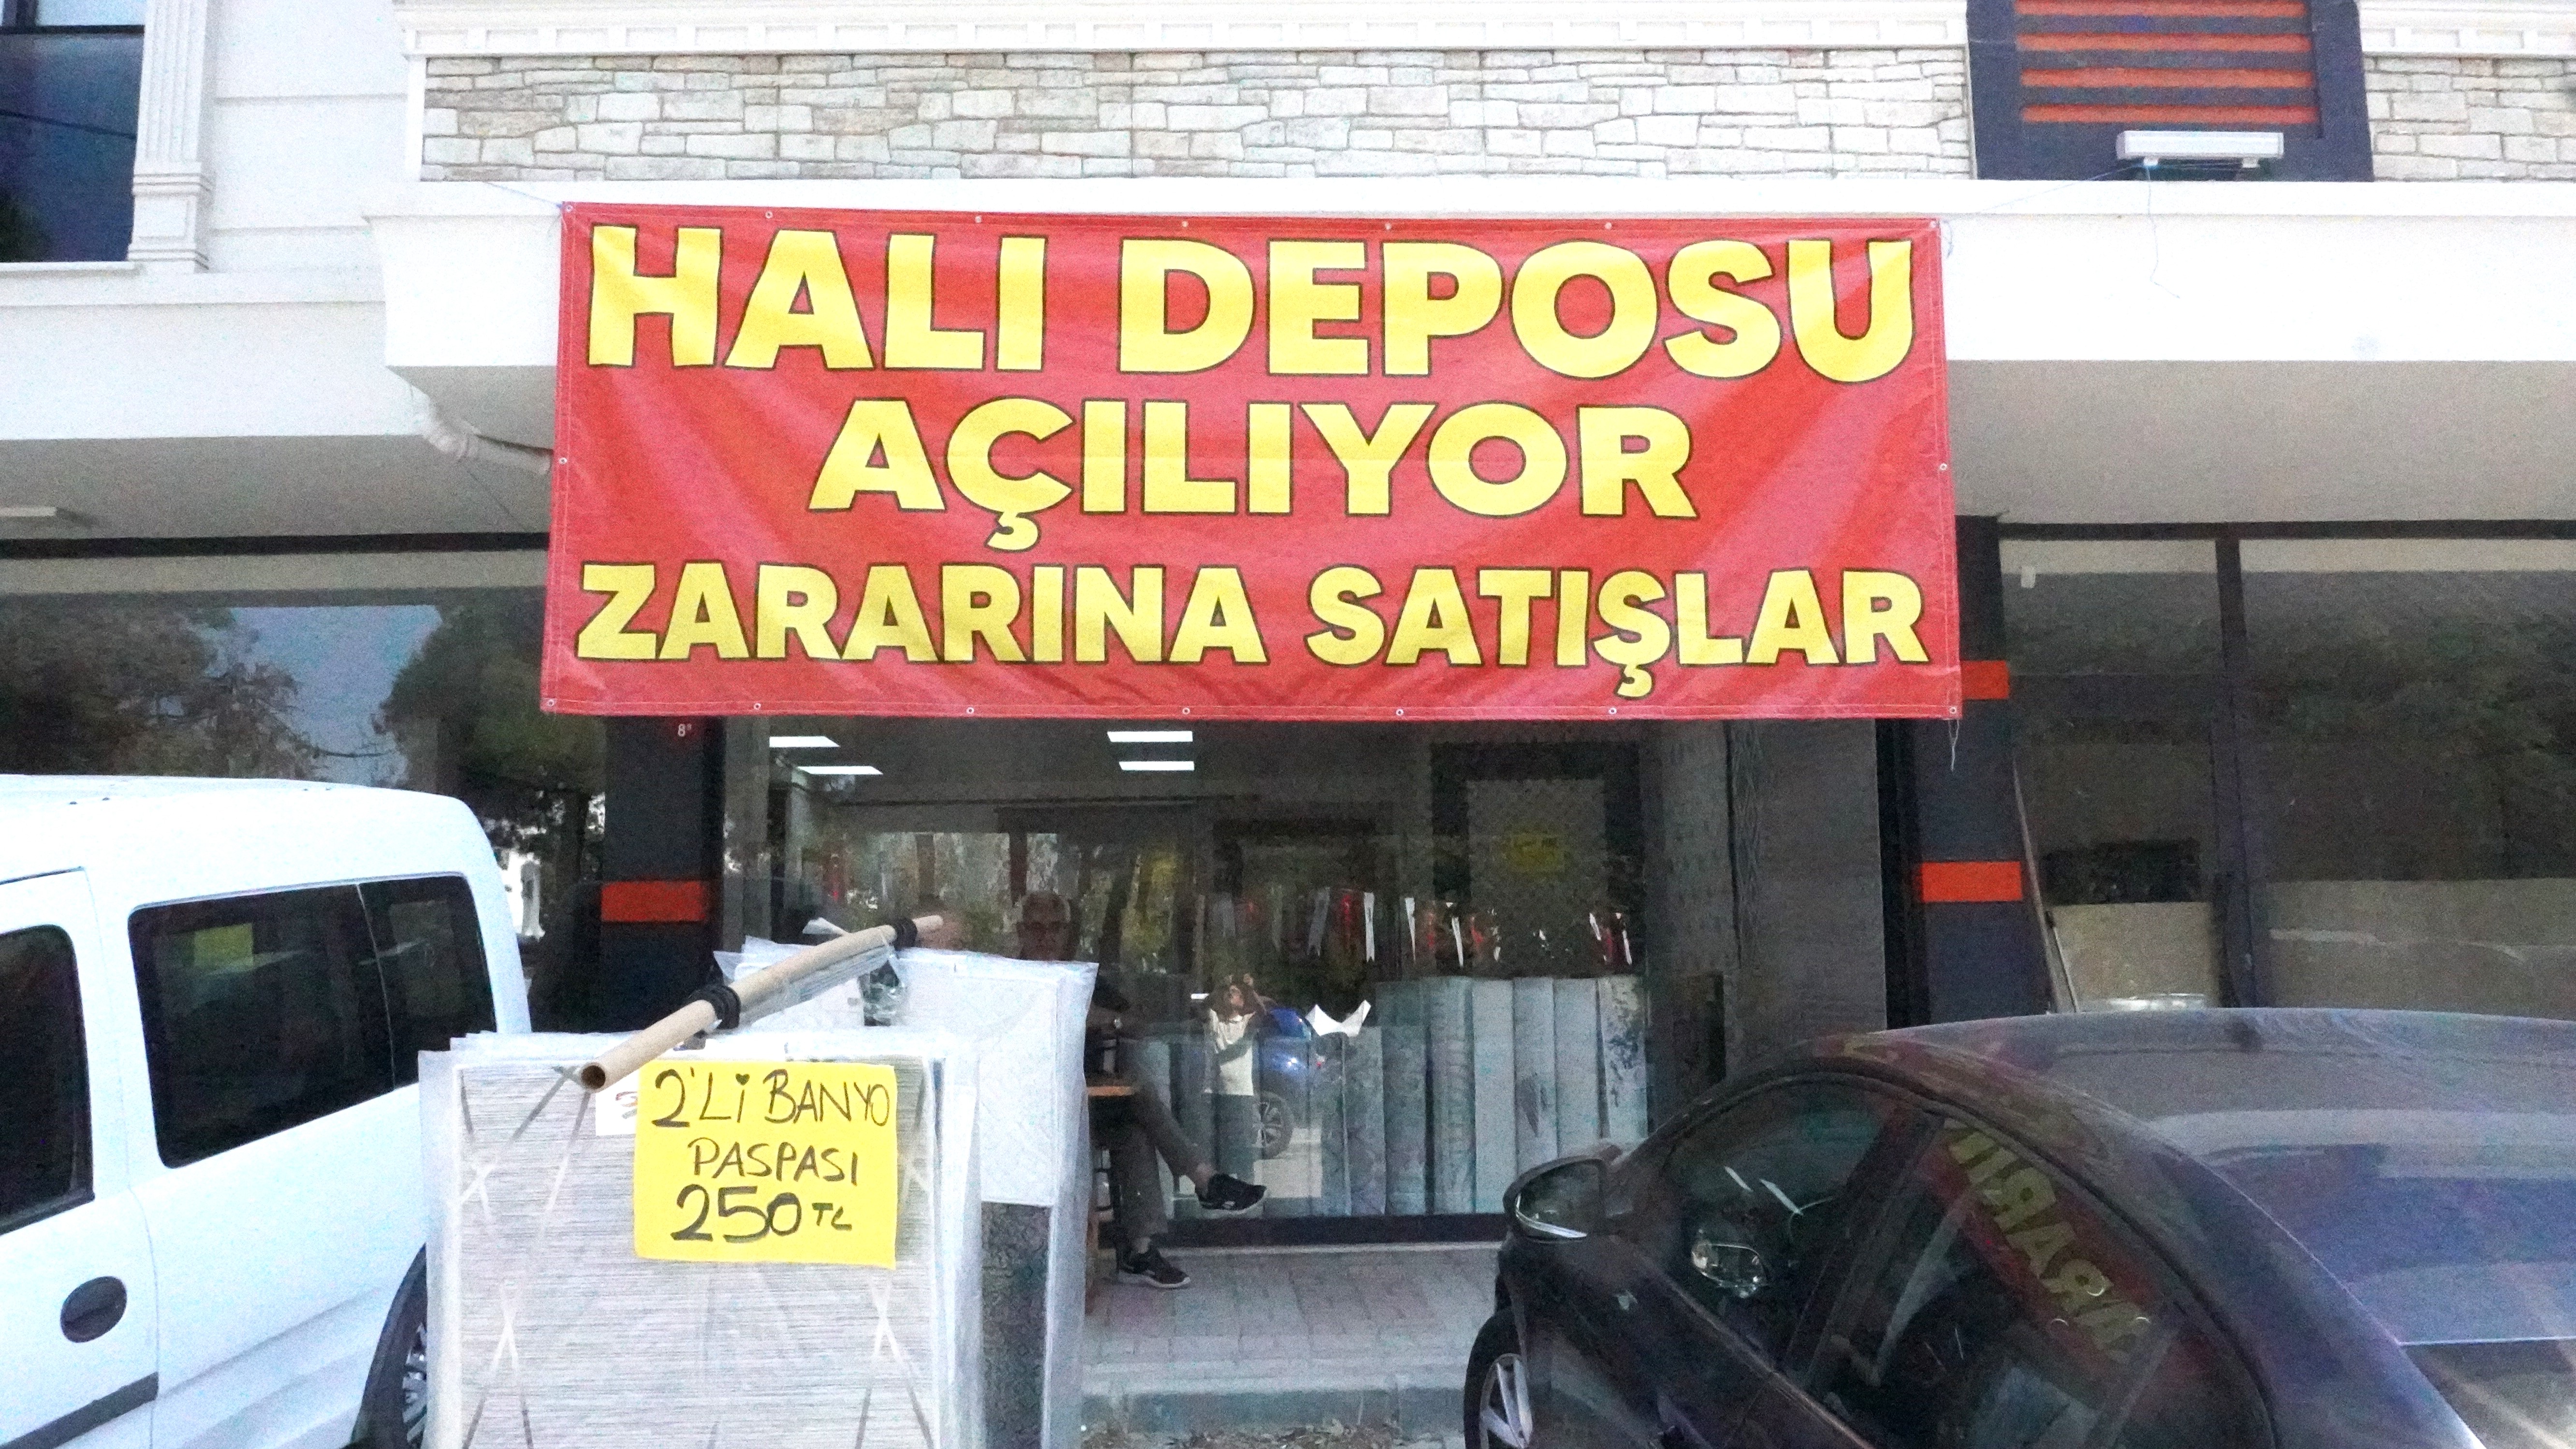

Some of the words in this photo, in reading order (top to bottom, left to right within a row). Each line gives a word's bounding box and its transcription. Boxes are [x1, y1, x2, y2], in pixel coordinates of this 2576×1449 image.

[587, 224, 1046, 371] HALI
[1118, 238, 1913, 382] DEPOSU
[808, 397, 1698, 551] AÇILIYOR
[576, 561, 1270, 665] ZARARINA
[1305, 564, 1931, 700] SATIŞLAR
[763, 1069, 891, 1126] BANYO
[688, 1138, 857, 1186] PASPASI
[671, 1185, 802, 1244] 250
